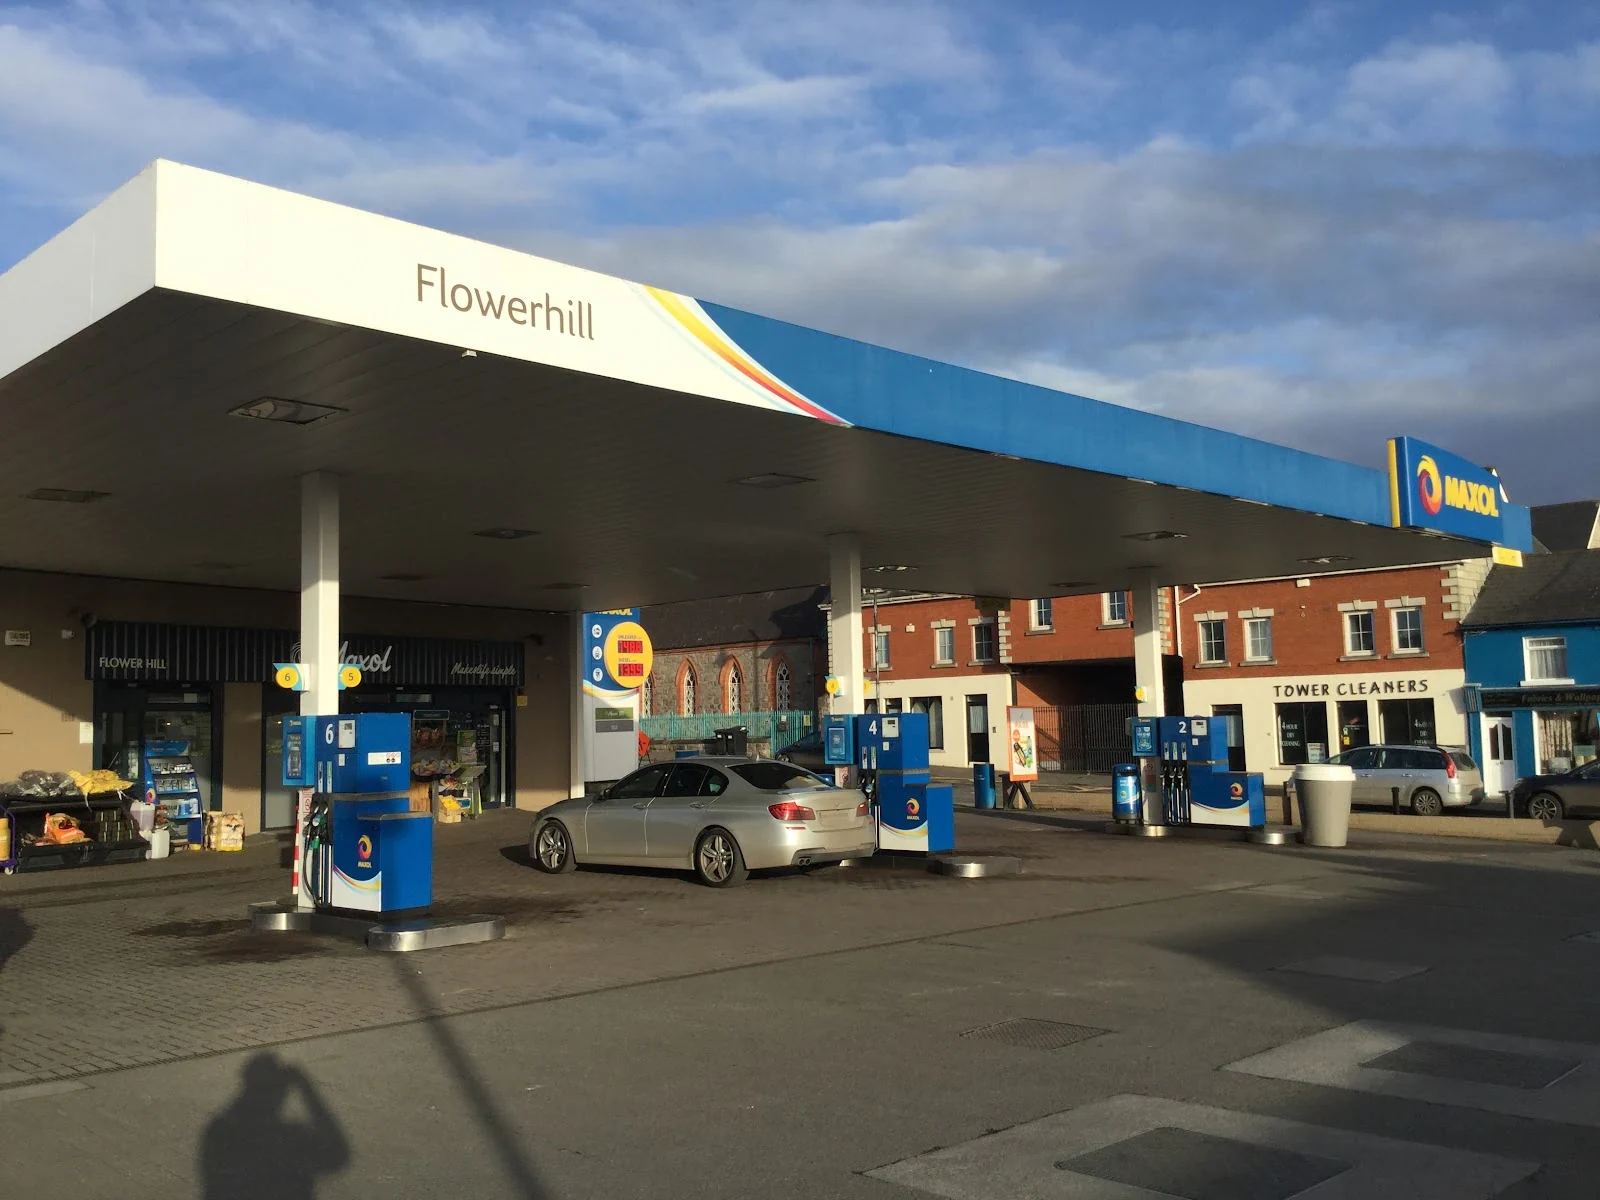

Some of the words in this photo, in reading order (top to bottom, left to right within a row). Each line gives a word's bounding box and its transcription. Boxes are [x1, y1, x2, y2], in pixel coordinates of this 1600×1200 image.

[417, 263, 594, 340] Flowerhill
[1445, 475, 1499, 517] MAXOL
[99, 657, 143, 669] FLOWER
[146, 658, 167, 669] HILL
[284, 673, 291, 681] 6
[348, 673, 354, 681] 5
[490, 664, 516, 679] simple
[1273, 683, 1330, 697] TOWER
[1337, 679, 1428, 696] CLEANERS
[1555, 694, 1562, 702] &
[868, 720, 878, 735] 4
[1178, 721, 1187, 734] 2
[1282, 721, 1286, 730] 4
[325, 723, 334, 744] 6
